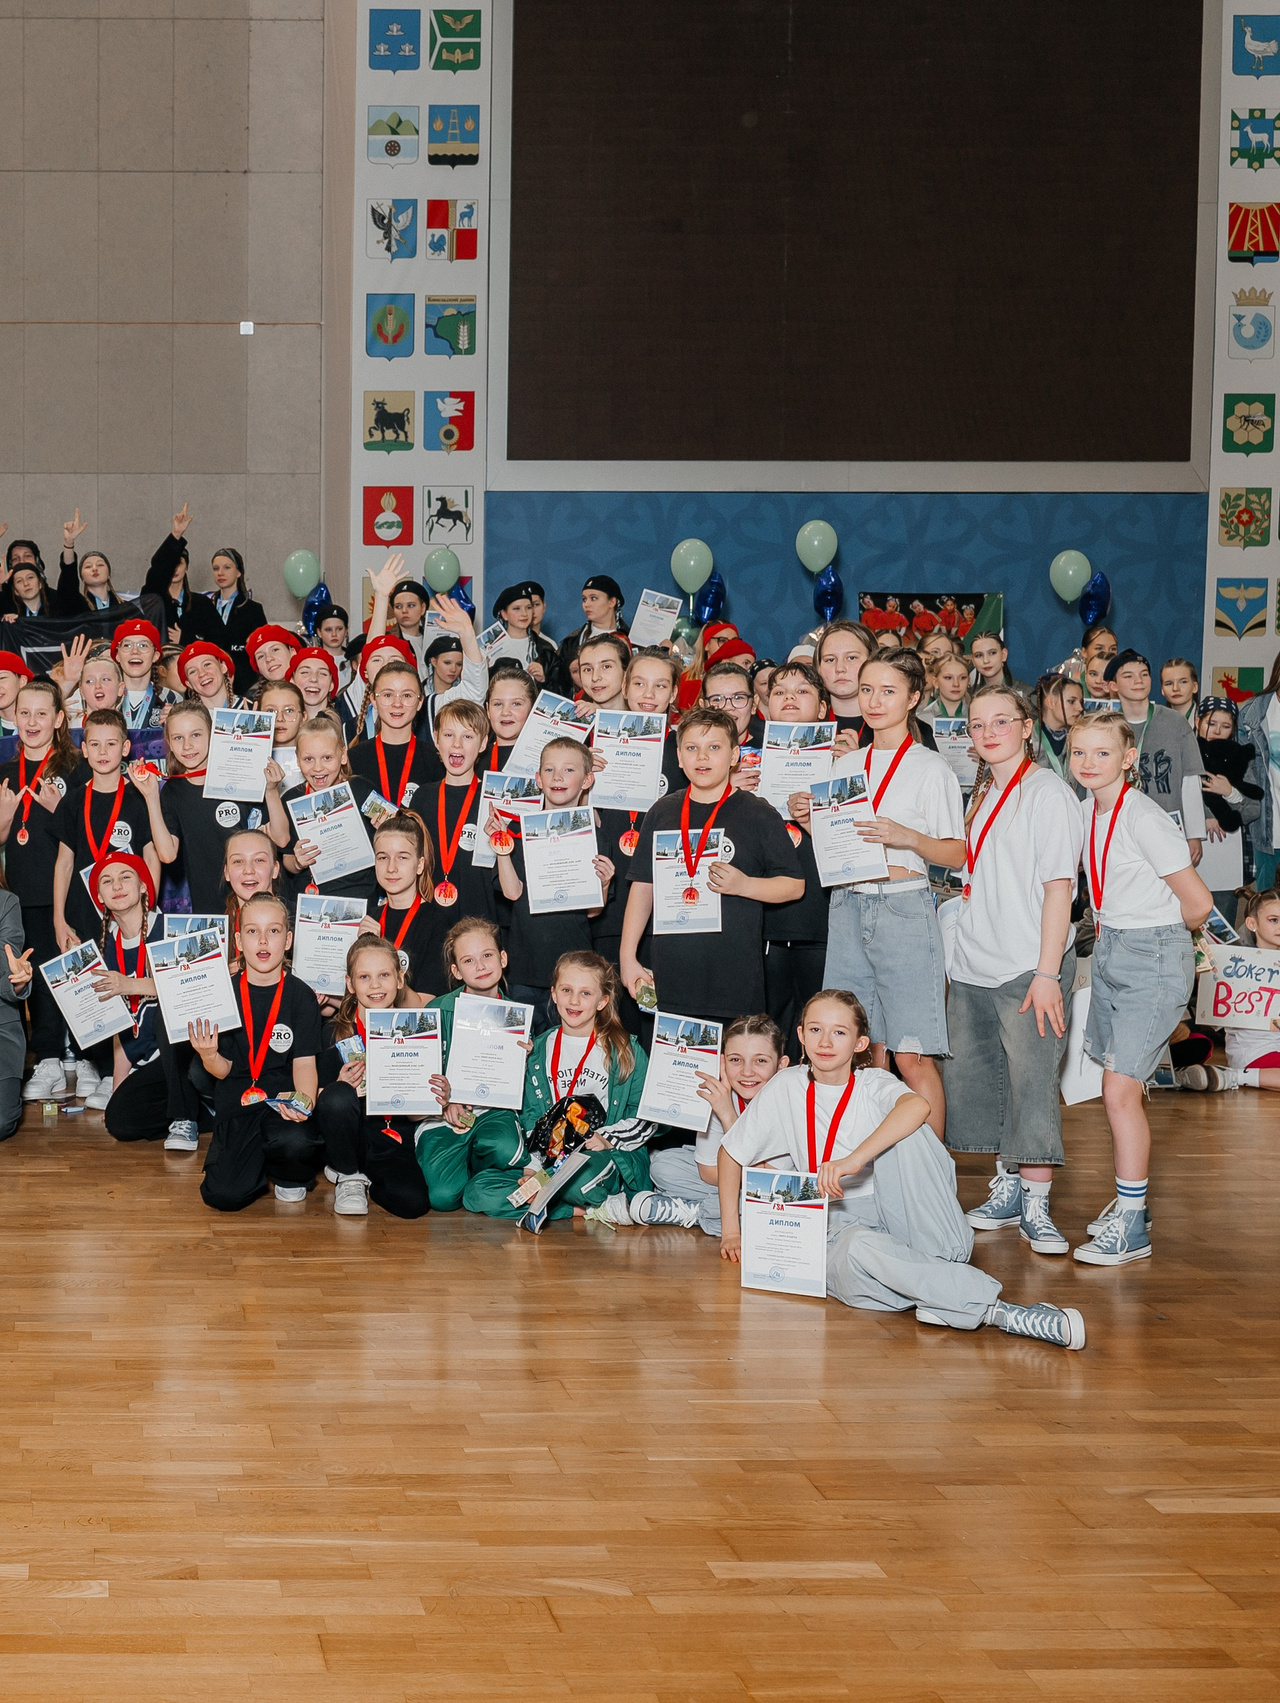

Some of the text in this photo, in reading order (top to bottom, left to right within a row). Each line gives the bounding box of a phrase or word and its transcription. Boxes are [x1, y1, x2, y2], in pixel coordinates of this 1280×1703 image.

[543, 729, 565, 739] ДИПЛО
[615, 750, 642, 758] ДИПЛОМ
[218, 808, 239, 818] PRO
[830, 817, 855, 827] ДИПЛОМ
[319, 823, 344, 836] ДИПЛОМ
[494, 837, 510, 847] FSA
[438, 889, 453, 899] FSA
[317, 935, 344, 943] ДИПЛОМ
[179, 963, 191, 971] FSA
[180, 973, 208, 985] ДИПЛОМ
[676, 1045, 688, 1053] FSA
[390, 1051, 419, 1059] ДИПЛОМ
[671, 1060, 700, 1070] ДИПЛОМ
[772, 1203, 785, 1211] FSA
[768, 1219, 801, 1229] ДИПЛОМ
